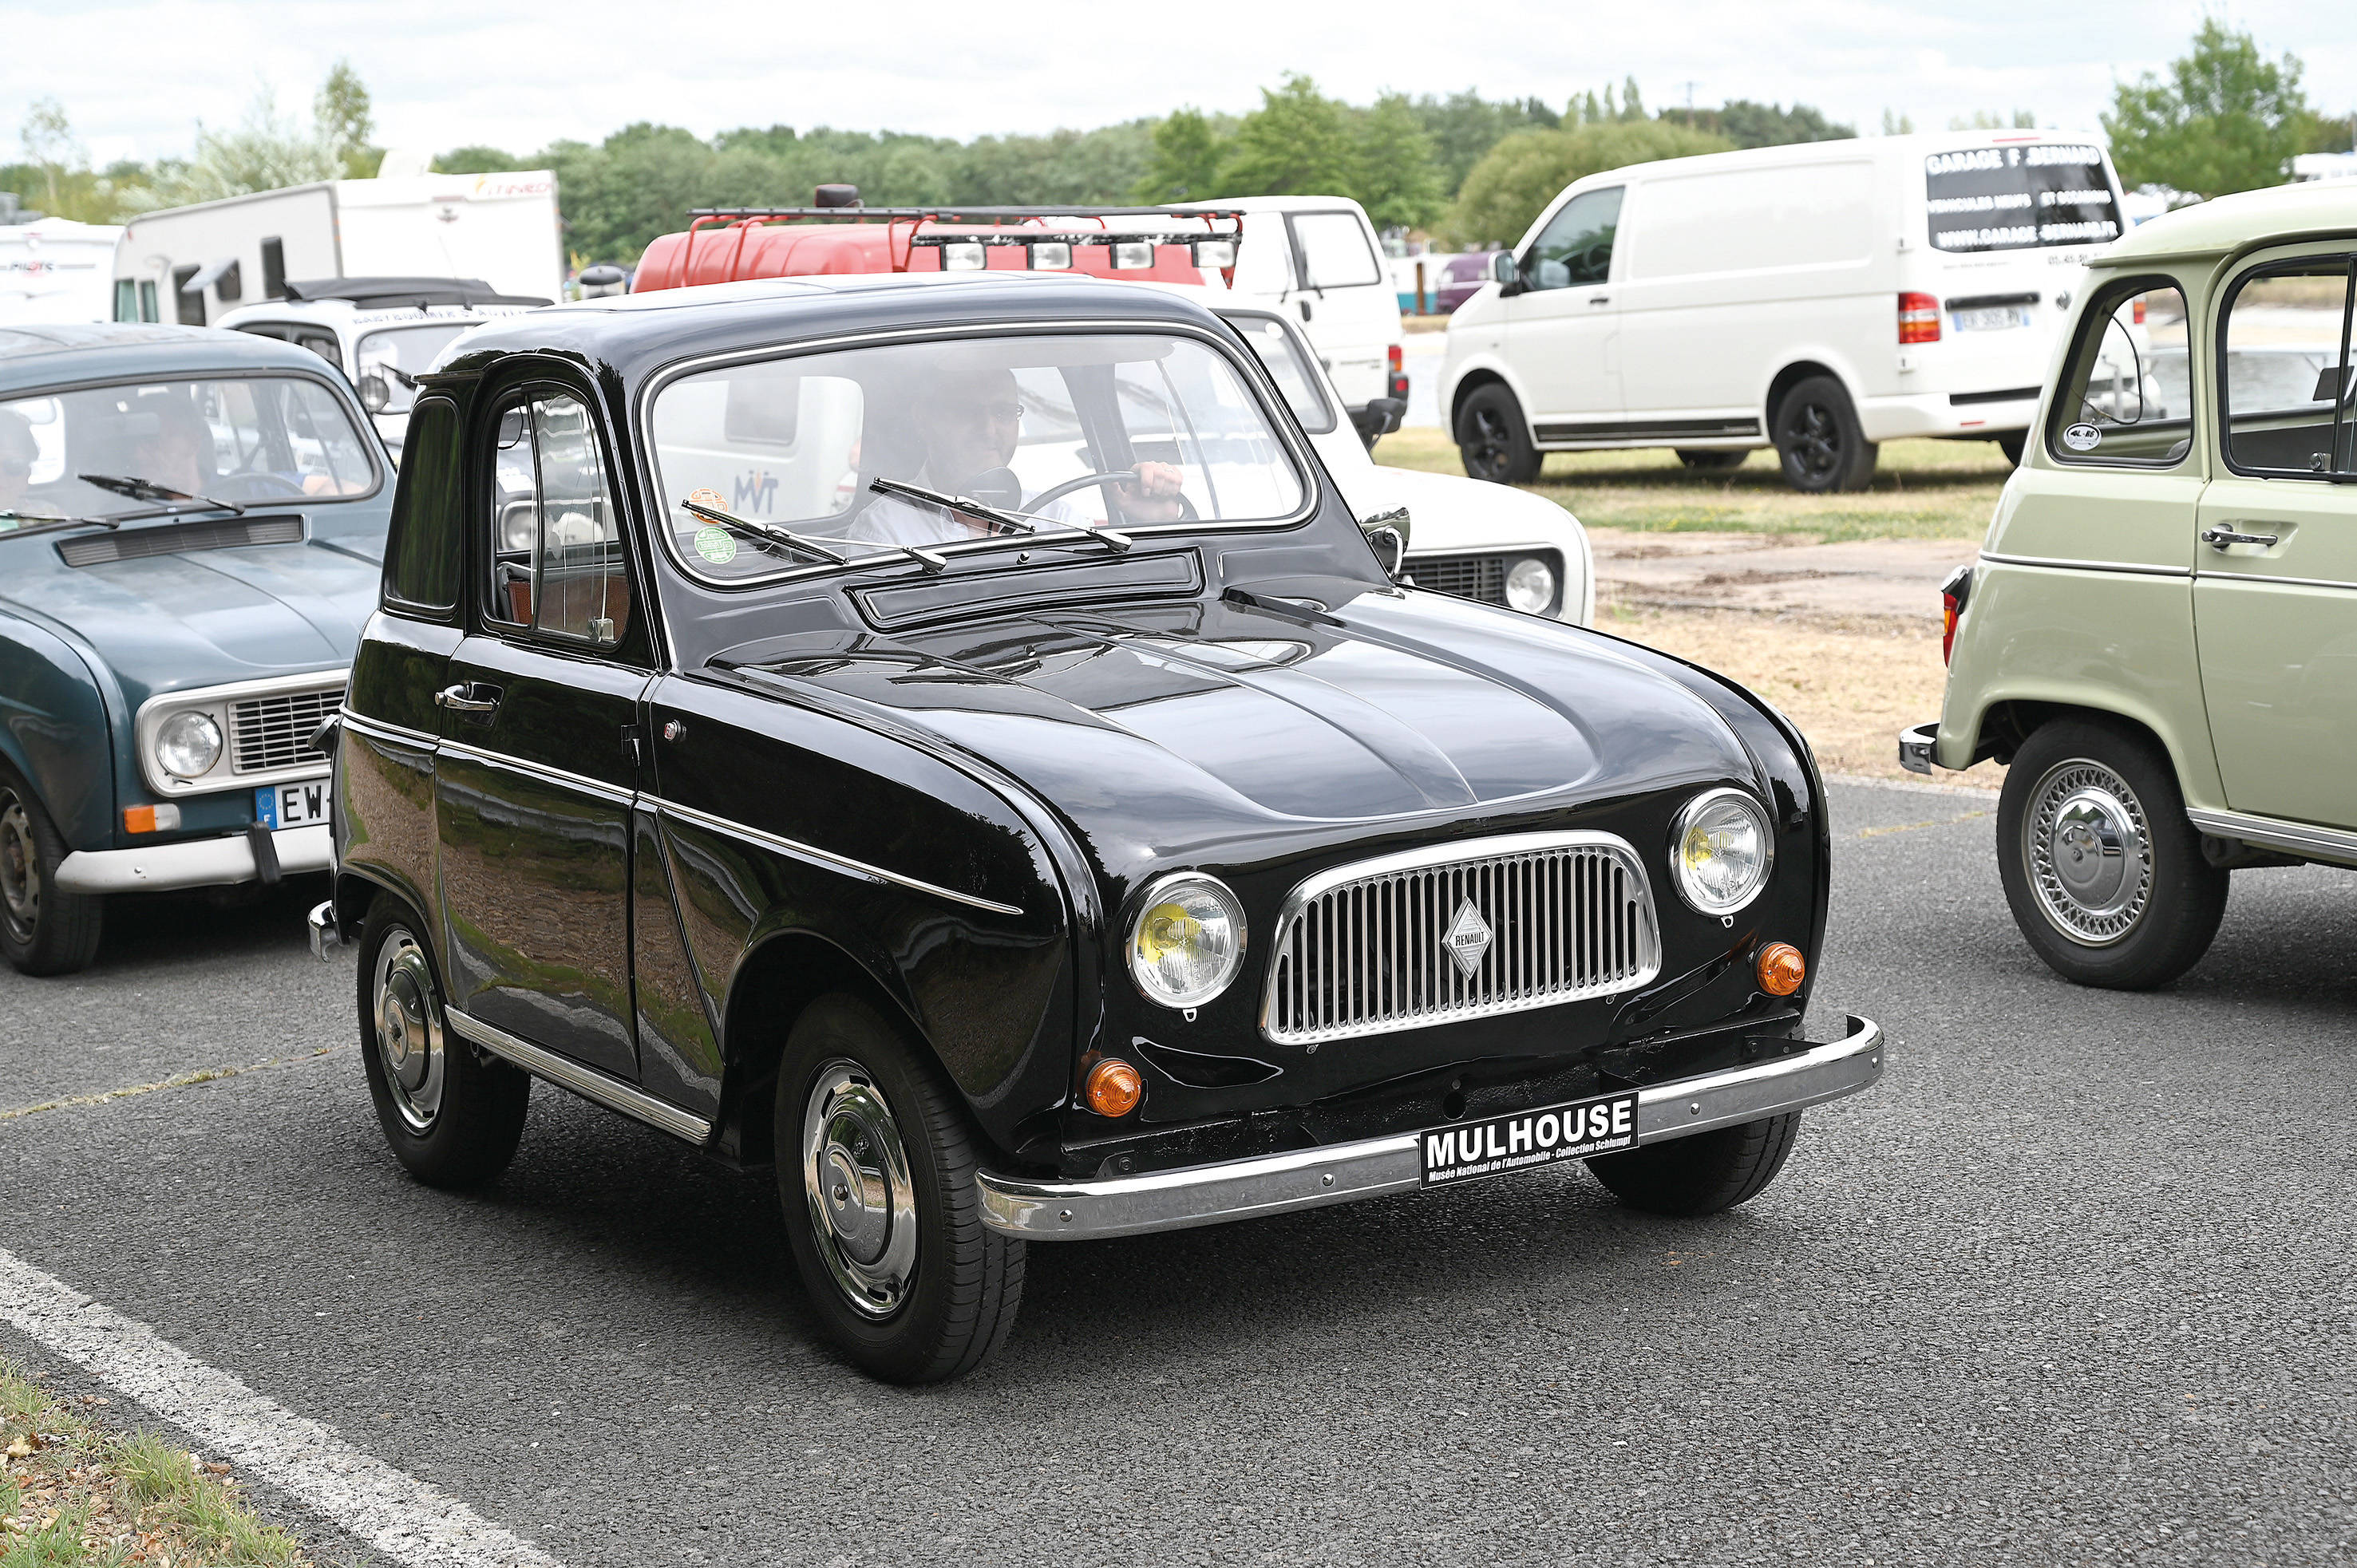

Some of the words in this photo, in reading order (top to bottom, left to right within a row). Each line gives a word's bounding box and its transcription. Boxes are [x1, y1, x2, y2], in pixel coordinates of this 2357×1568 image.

[1927, 149, 2003, 175] GARAGE
[282, 785, 322, 823] EW
[1455, 931, 1485, 946] RENAULT
[1427, 1099, 1631, 1169] MULHOUSE
[1428, 1168, 1455, 1183] Musée
[1456, 1161, 1490, 1177] National
[1490, 1159, 1501, 1171] de
[1501, 1151, 1550, 1169] l'Automobile
[1556, 1143, 1595, 1159] Collection
[1595, 1134, 1631, 1151] Schlumpf
